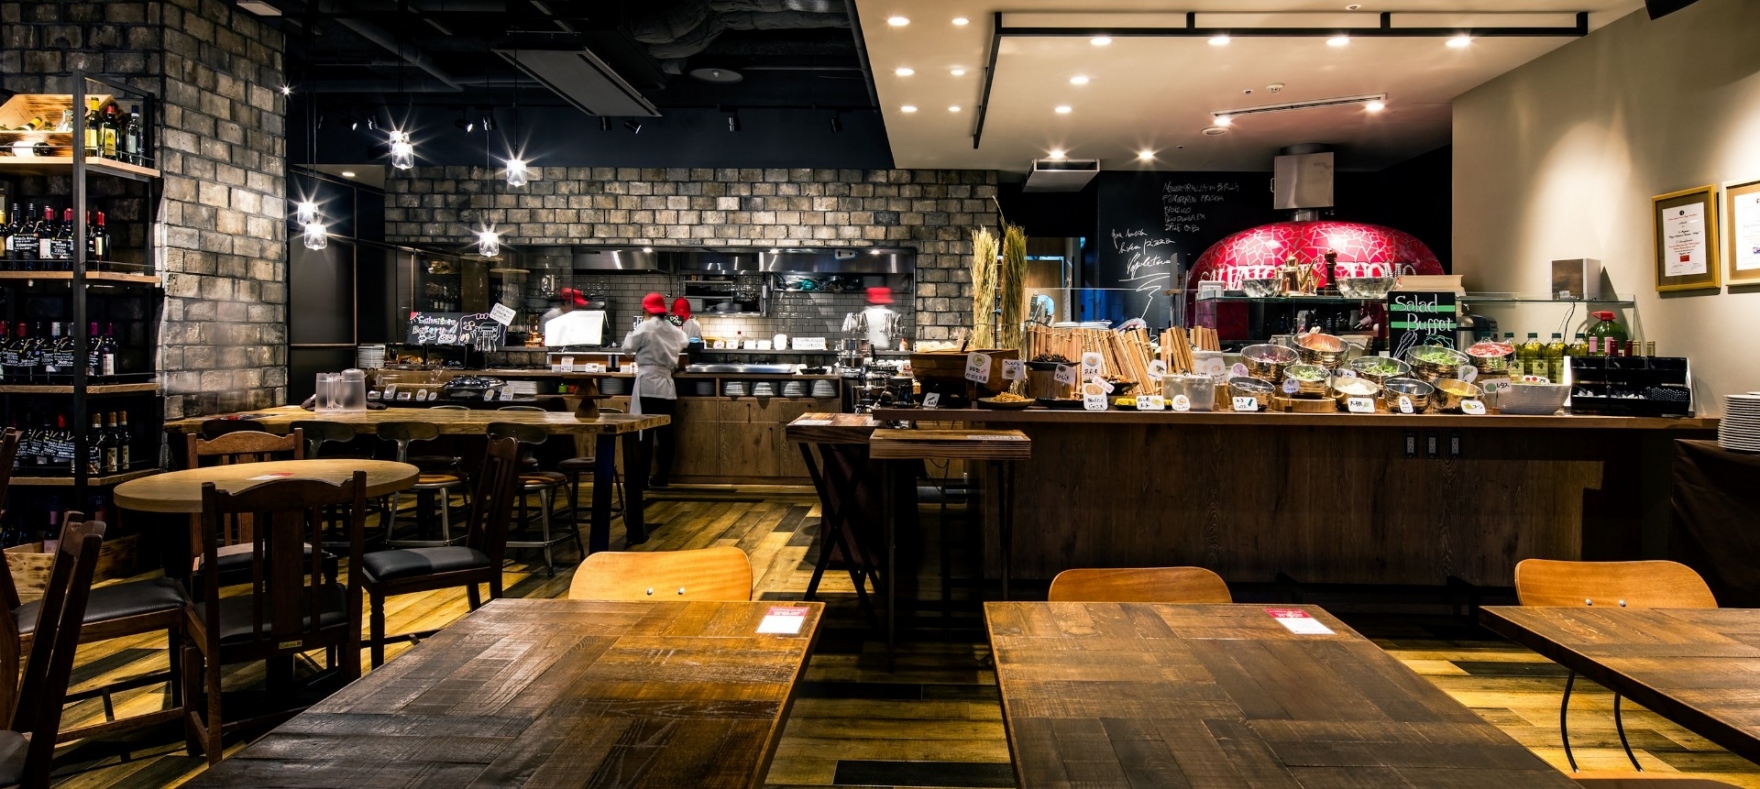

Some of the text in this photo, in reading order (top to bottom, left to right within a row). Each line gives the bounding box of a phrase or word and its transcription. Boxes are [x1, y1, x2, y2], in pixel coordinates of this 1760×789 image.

[1143, 237, 1176, 255] pizza
[1395, 293, 1439, 314] Salad
[1407, 312, 1454, 336] Buffet
[1496, 381, 1510, 389] レタス
